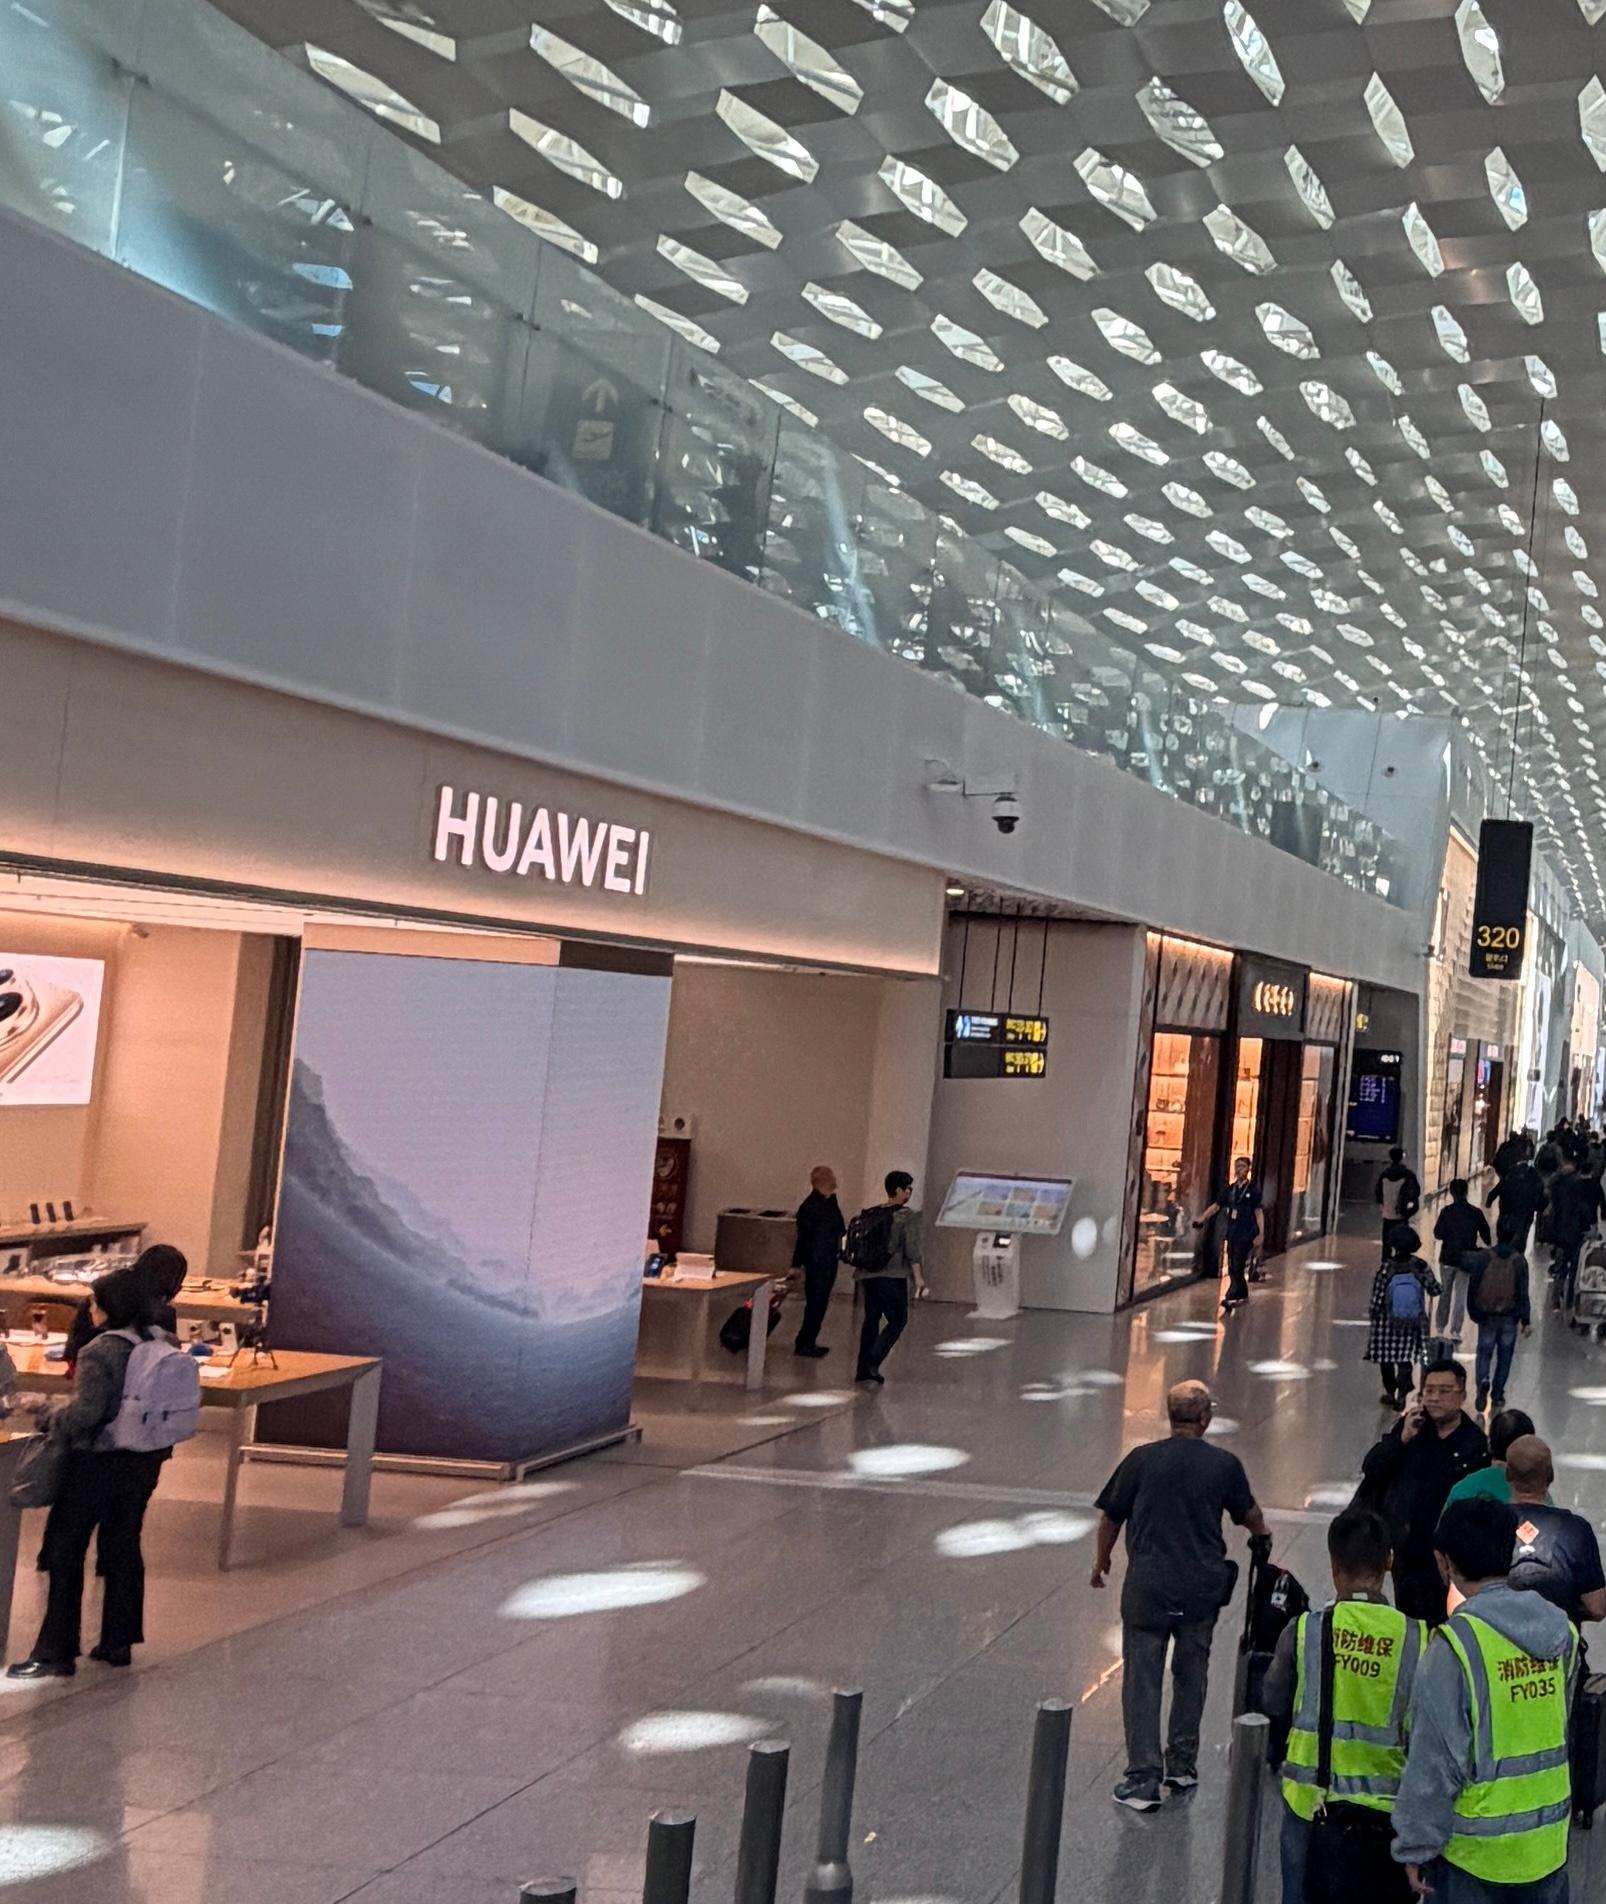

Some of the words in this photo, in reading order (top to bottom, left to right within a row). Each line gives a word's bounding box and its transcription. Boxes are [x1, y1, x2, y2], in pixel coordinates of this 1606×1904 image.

[434, 785, 650, 896] HUAWEI
[1477, 925, 1520, 949] 320
[1510, 1676, 1556, 1703] FY035
